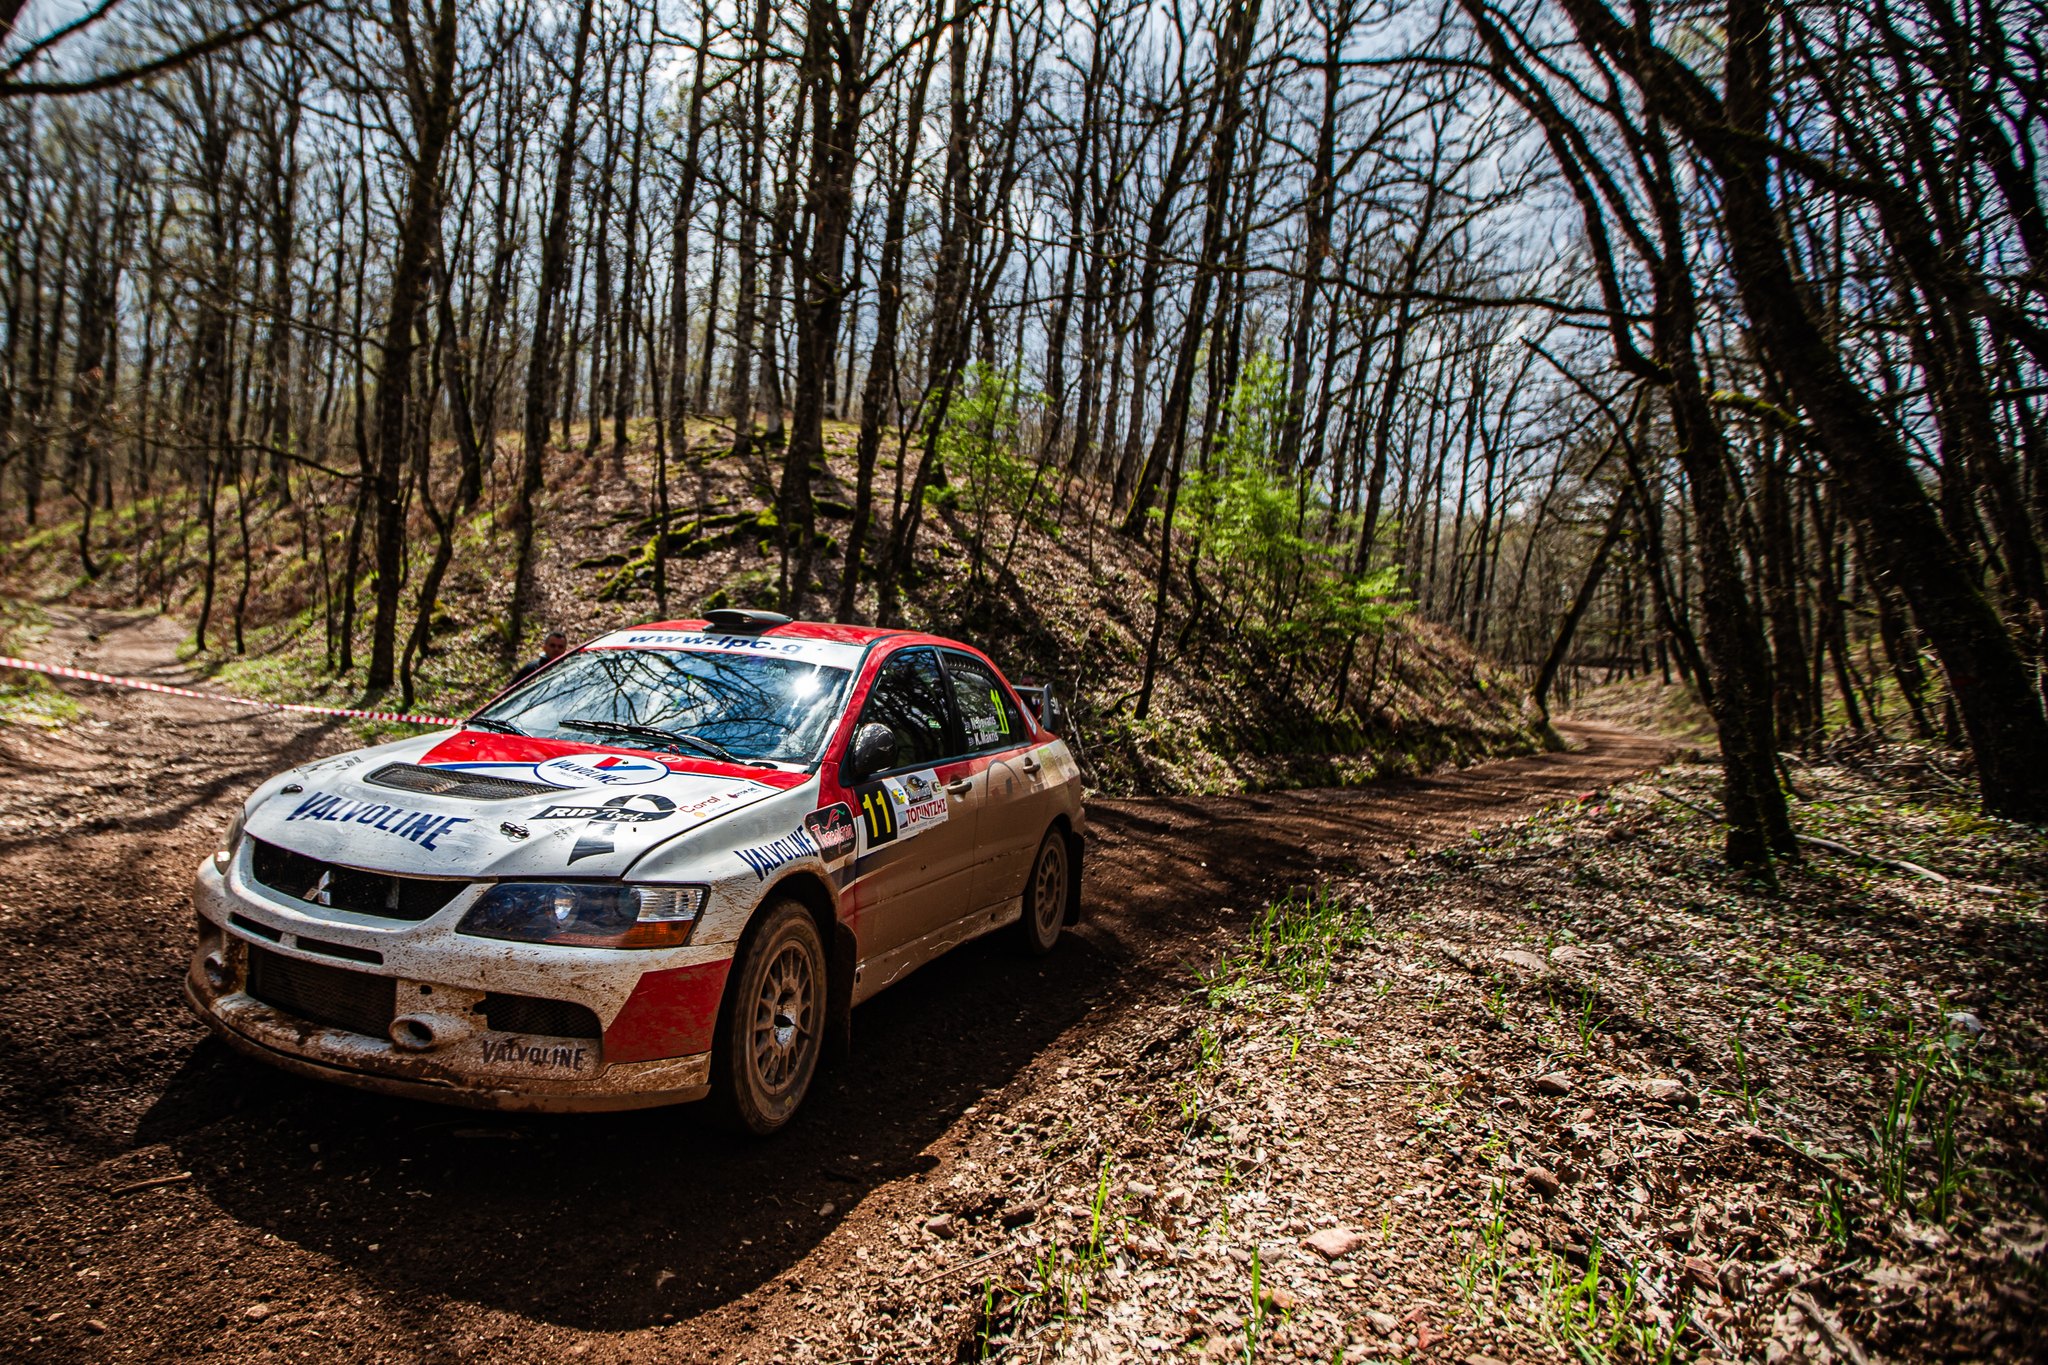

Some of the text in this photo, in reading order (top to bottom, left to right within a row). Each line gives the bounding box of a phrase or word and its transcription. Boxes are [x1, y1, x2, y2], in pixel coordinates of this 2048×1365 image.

[628, 635, 822, 655] www.lpc.g
[990, 688, 1009, 734] 11
[546, 759, 627, 785] VALVOLINE
[544, 807, 598, 819] RIP
[679, 796, 721, 813] Coral
[863, 790, 891, 838] 11
[285, 791, 475, 852] VALVOLINE
[733, 824, 818, 882] VALVOLINE
[482, 1039, 587, 1072] VALVOLINE
